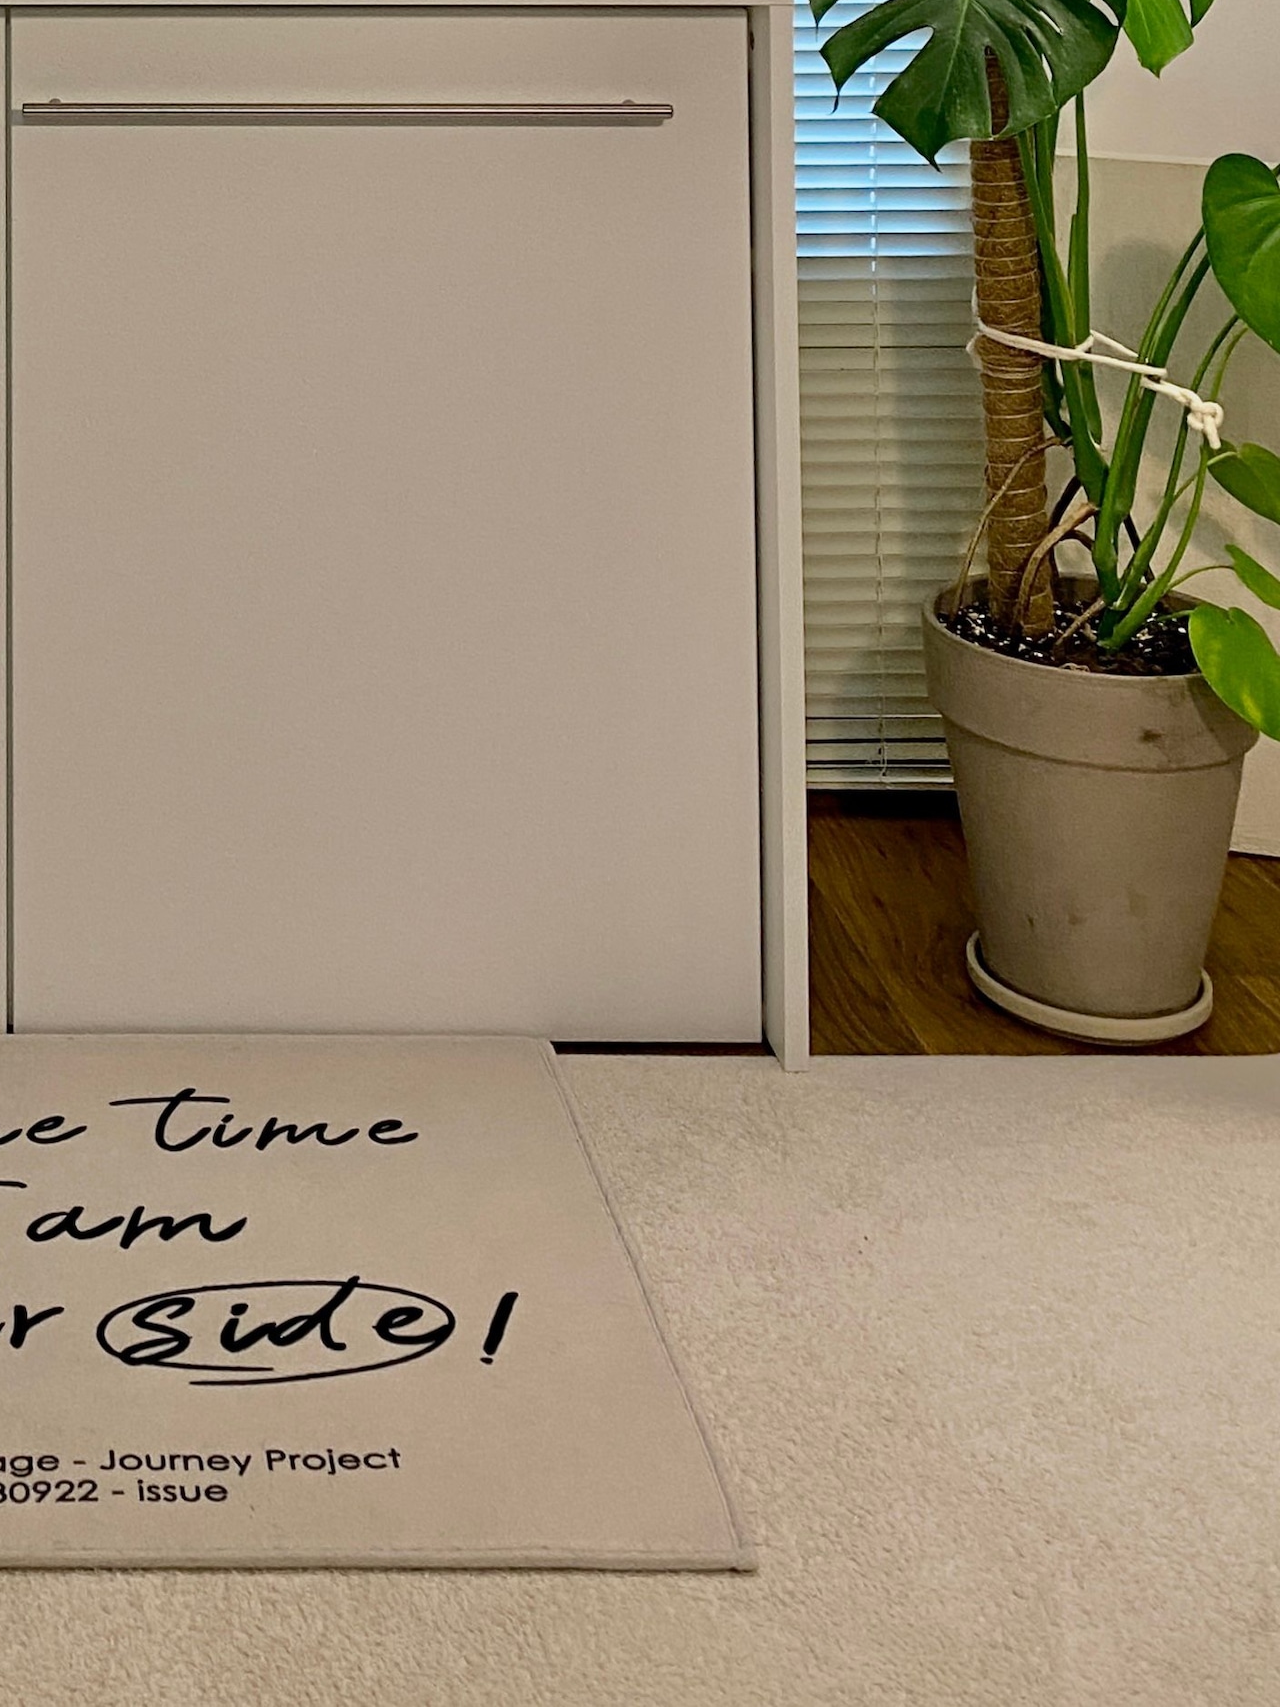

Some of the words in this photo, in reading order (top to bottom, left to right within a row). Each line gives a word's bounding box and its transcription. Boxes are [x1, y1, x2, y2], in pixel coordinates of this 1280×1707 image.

[109, 1088, 420, 1152] time
[25, 1204, 249, 1250] am
[99, 1449, 253, 1477] Journey
[265, 1447, 403, 1476] Project
[137, 1479, 230, 1502] issue
